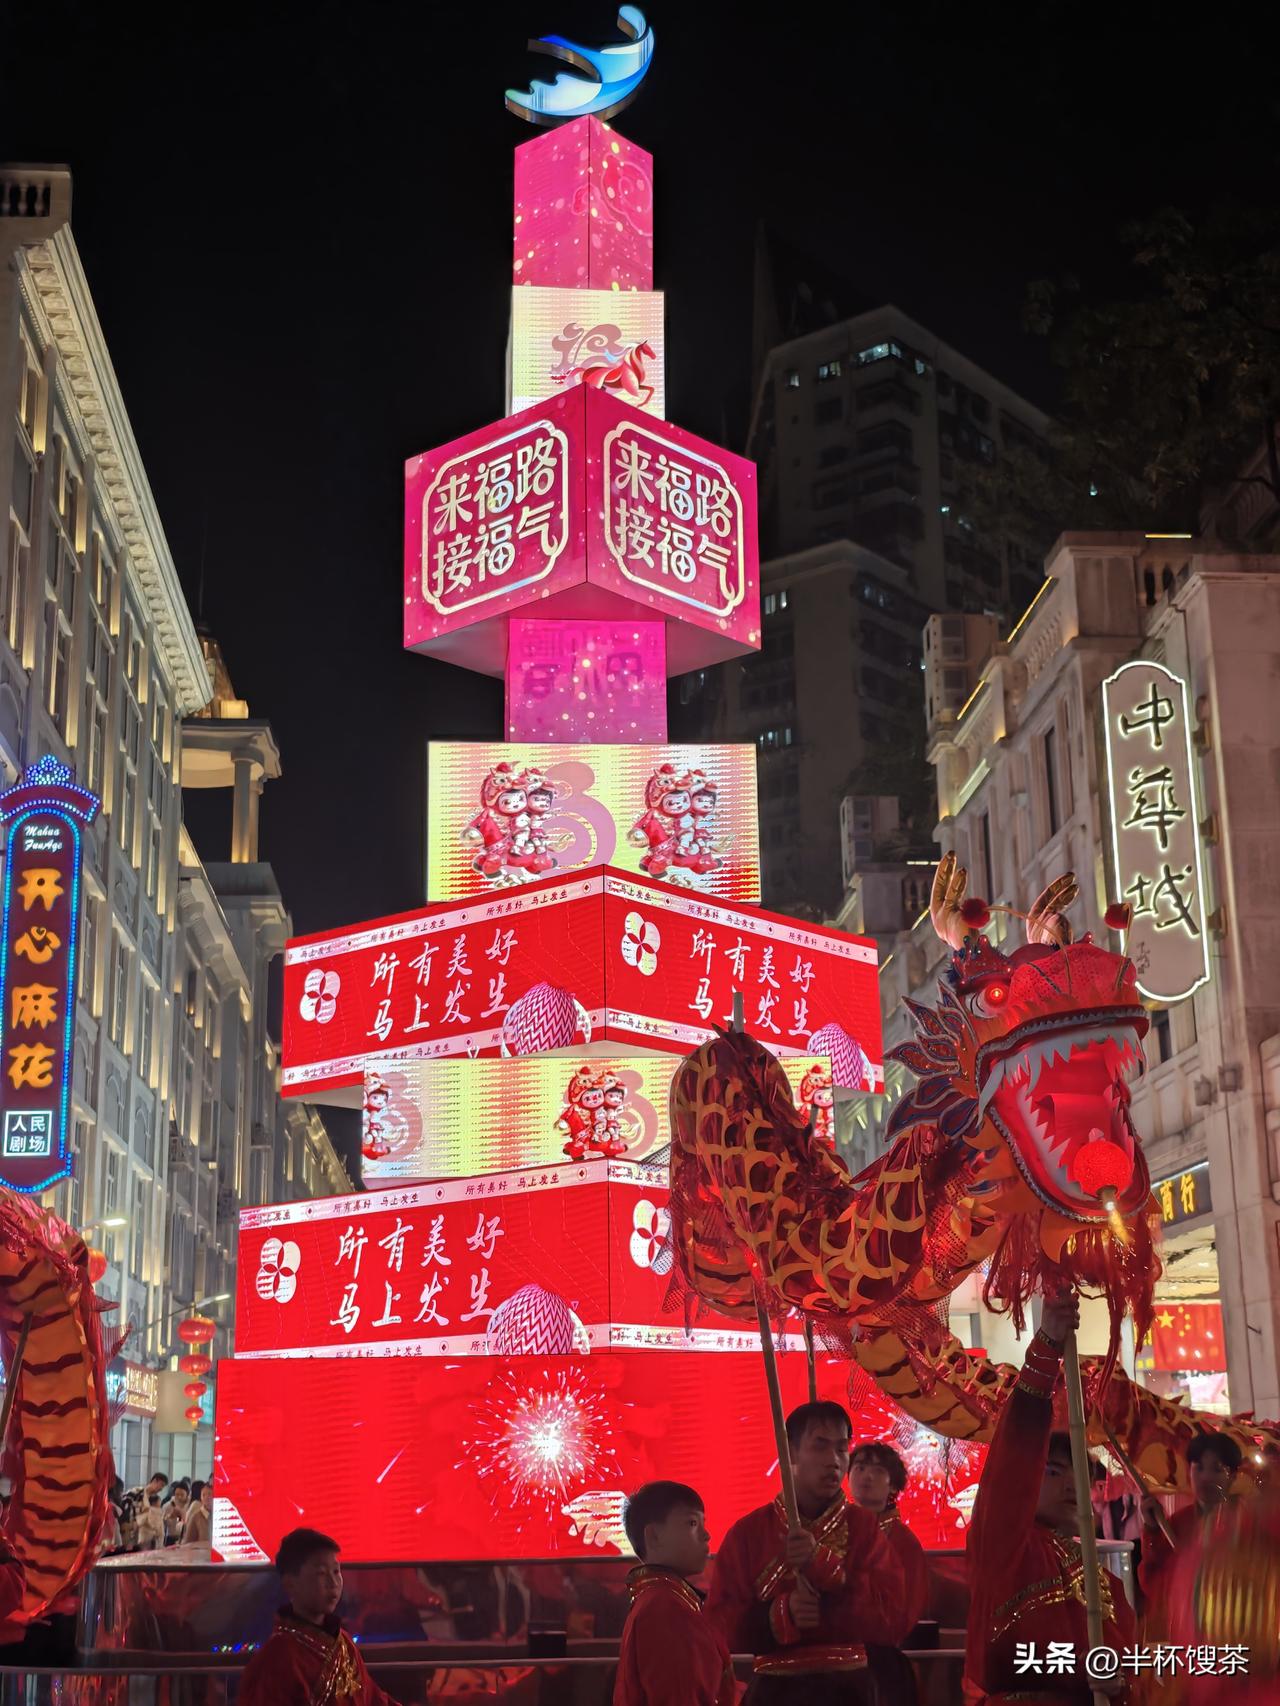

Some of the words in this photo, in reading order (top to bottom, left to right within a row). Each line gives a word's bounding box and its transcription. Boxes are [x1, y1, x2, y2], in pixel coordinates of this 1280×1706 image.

[433, 437, 557, 536] 来福路
[614, 439, 734, 538] 来福路
[431, 500, 559, 599] 接福气
[614, 498, 736, 602] 接福气
[24, 825, 60, 837] Mahua
[486, 901, 523, 917] 所有美好
[530, 889, 569, 906] 马上发生
[8, 867, 64, 1091] 开心麻花
[370, 928, 519, 997] 所有美好
[690, 928, 816, 993] 所有美好
[366, 972, 512, 1042] 马上发生
[9, 1135, 46, 1153] 剧场
[11, 1115, 46, 1133] 人民
[380, 1193, 420, 1207] 马上发生
[465, 1181, 508, 1196] 所有美好
[517, 1174, 560, 1189] 马上发生
[335, 1212, 505, 1280] 所有美好
[329, 1267, 496, 1334] 马上发生
[716, 1335, 754, 1349] 所有美好
